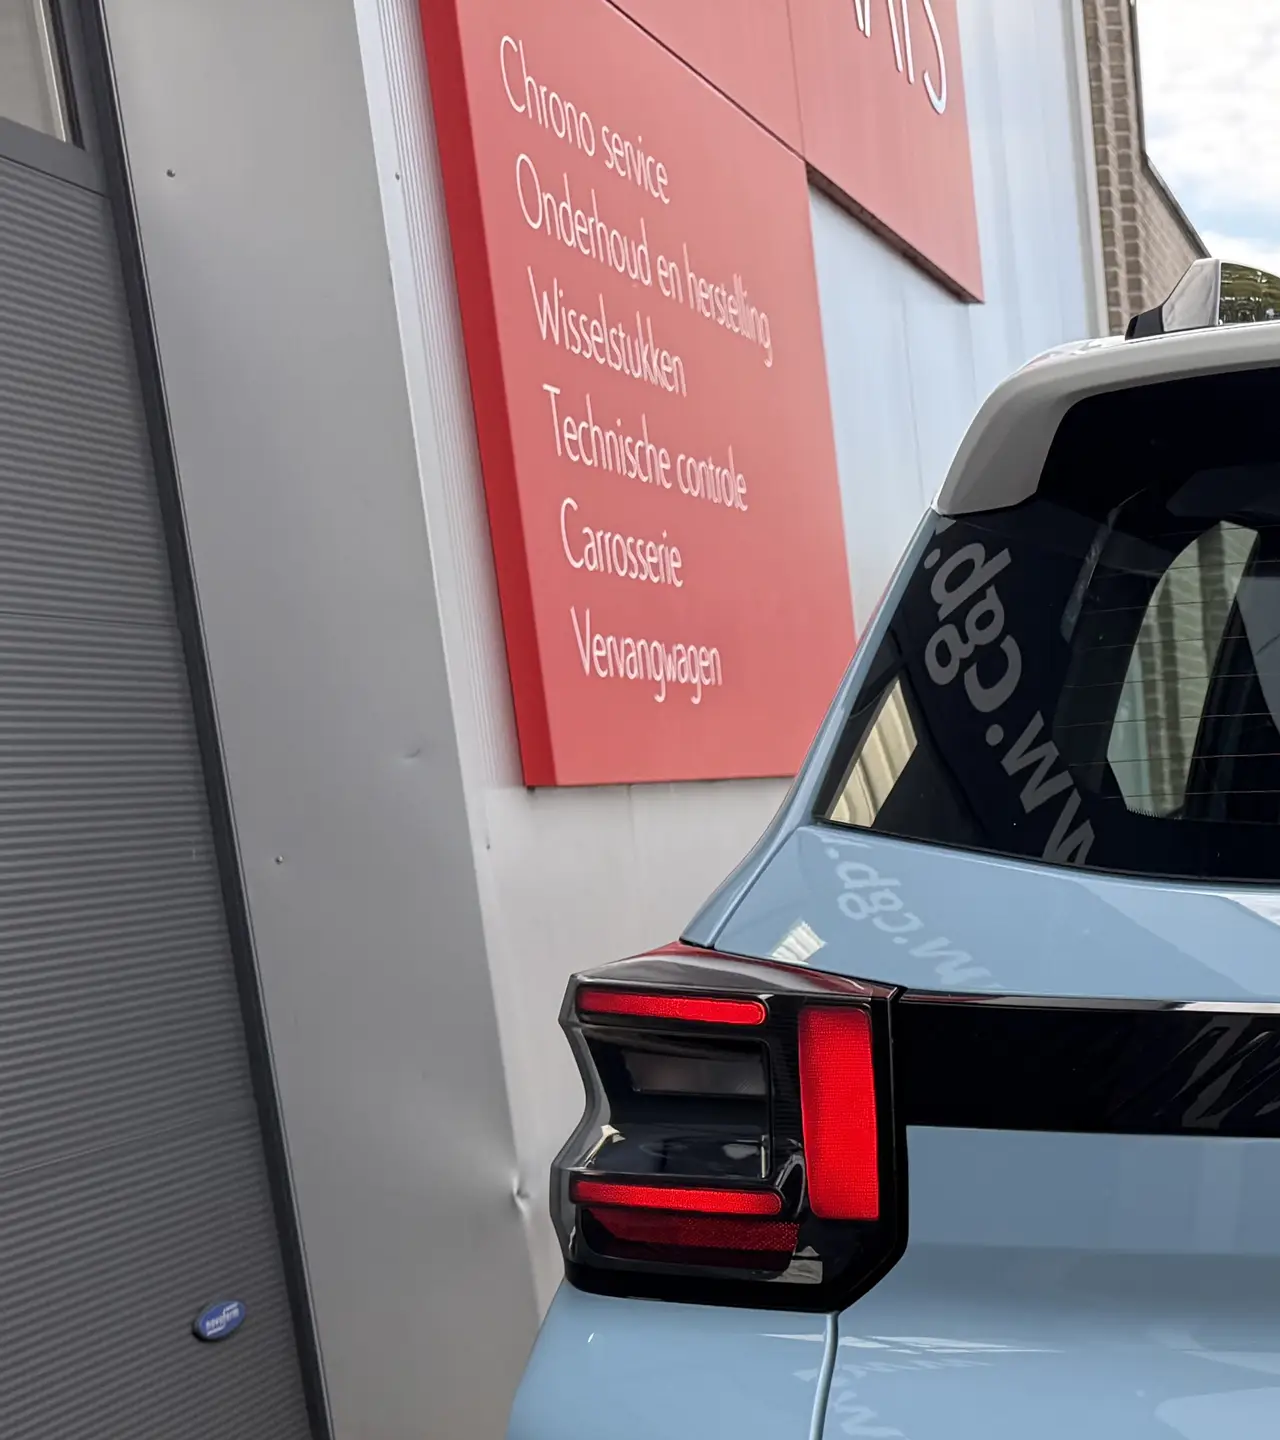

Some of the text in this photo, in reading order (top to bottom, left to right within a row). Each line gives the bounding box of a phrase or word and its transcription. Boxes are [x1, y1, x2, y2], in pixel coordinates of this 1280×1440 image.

[500, 35, 670, 204] Chrono service
[516, 153, 773, 368] Onderhoud en herstelling
[527, 265, 687, 398] Wisselstukken
[542, 383, 748, 511] Technische controle
[560, 497, 683, 588] Carrosserie
[570, 606, 722, 704] Vervangwagen
